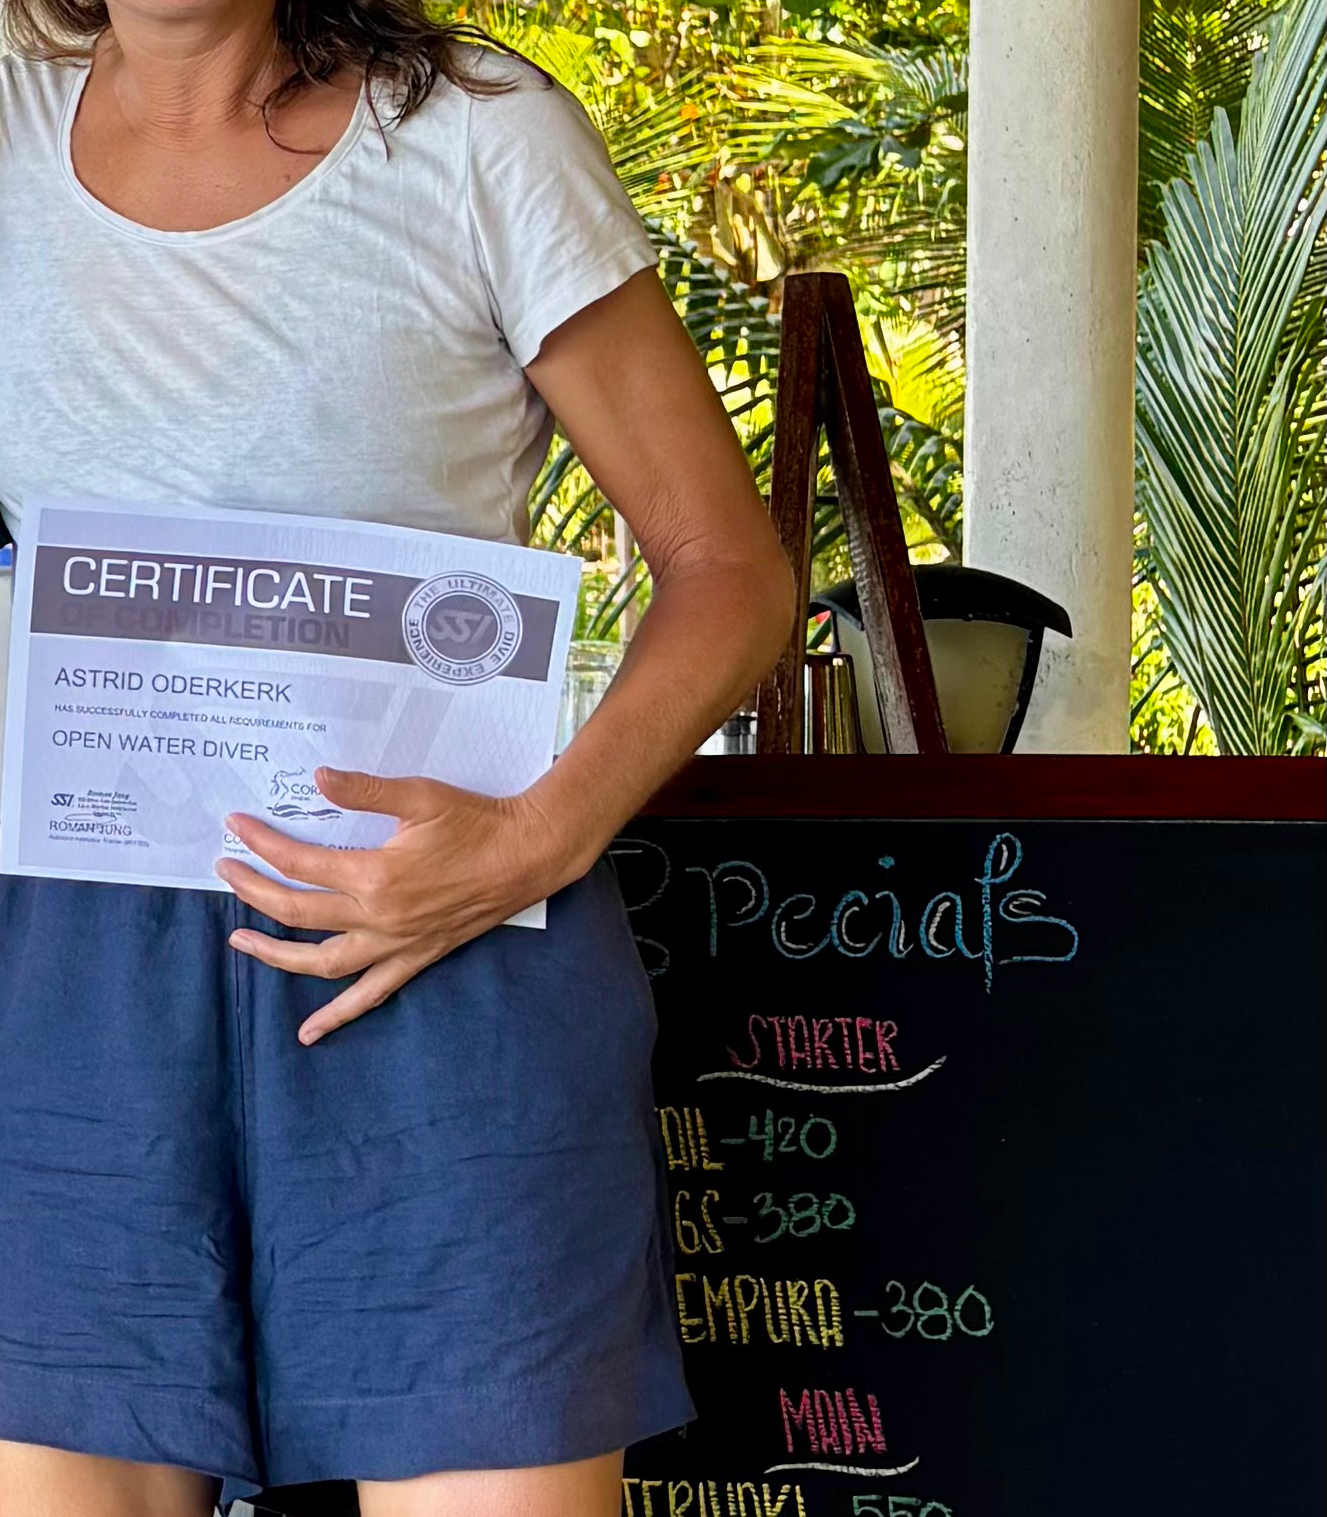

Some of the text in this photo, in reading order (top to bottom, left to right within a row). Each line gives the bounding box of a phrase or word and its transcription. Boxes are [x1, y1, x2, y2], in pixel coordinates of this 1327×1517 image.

[64, 556, 373, 618] CERTIFICATE
[413, 585, 440, 609] THE
[448, 579, 513, 622] ULTIMATE
[489, 631, 515, 665] DIVE
[54, 667, 292, 703] ASTRID ODERKERK
[52, 730, 269, 762] OPEN WATER DIVER
[291, 783, 323, 795] COR
[725, 1015, 900, 1073] STARTER
[780, 1388, 888, 1455] MAIN
